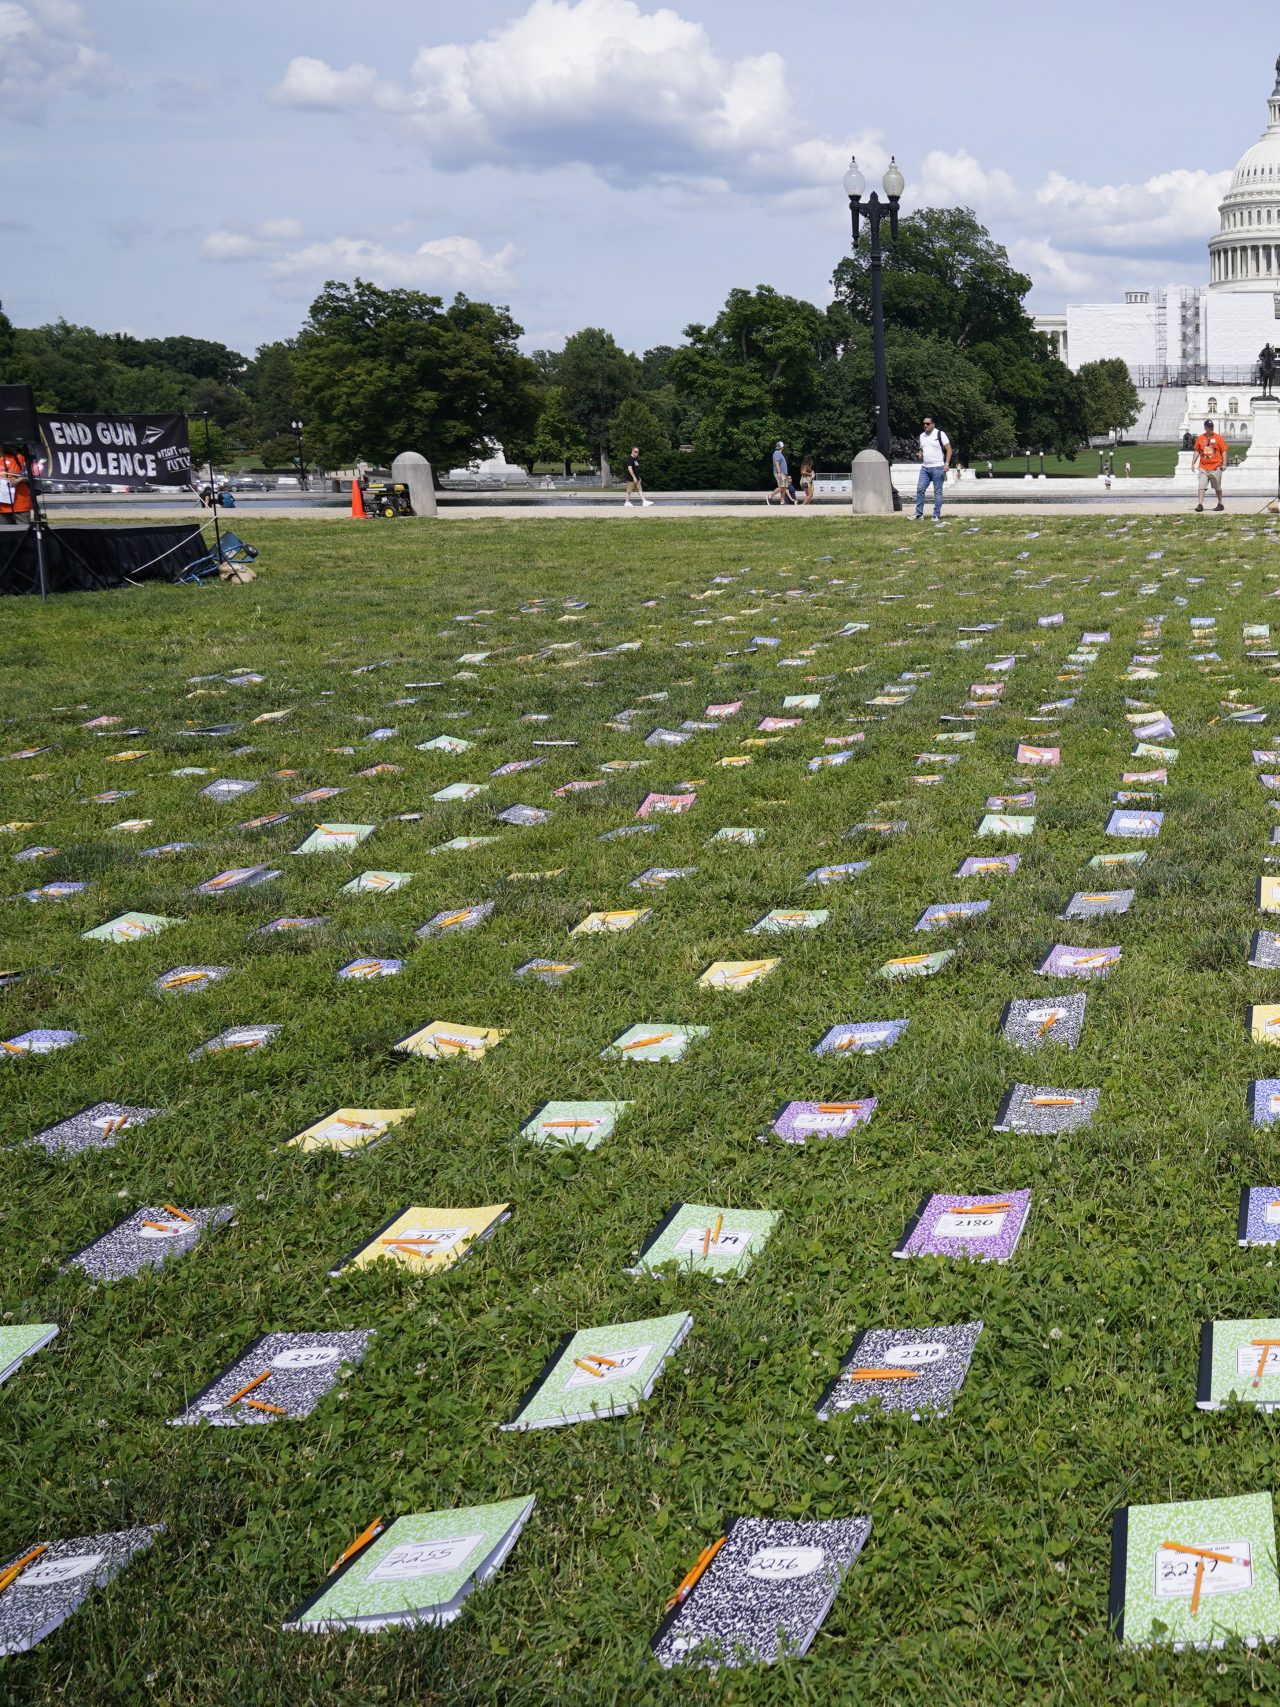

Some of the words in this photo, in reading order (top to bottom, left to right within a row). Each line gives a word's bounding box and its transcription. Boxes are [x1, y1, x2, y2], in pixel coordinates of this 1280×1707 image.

[50, 422, 92, 446] END
[96, 422, 138, 446] GUN
[58, 452, 157, 477] VIOLENCE
[959, 1219, 994, 1227] 2180
[291, 1353, 332, 1362] 2216
[901, 1348, 940, 1360] 2218
[751, 1556, 800, 1571] 2256
